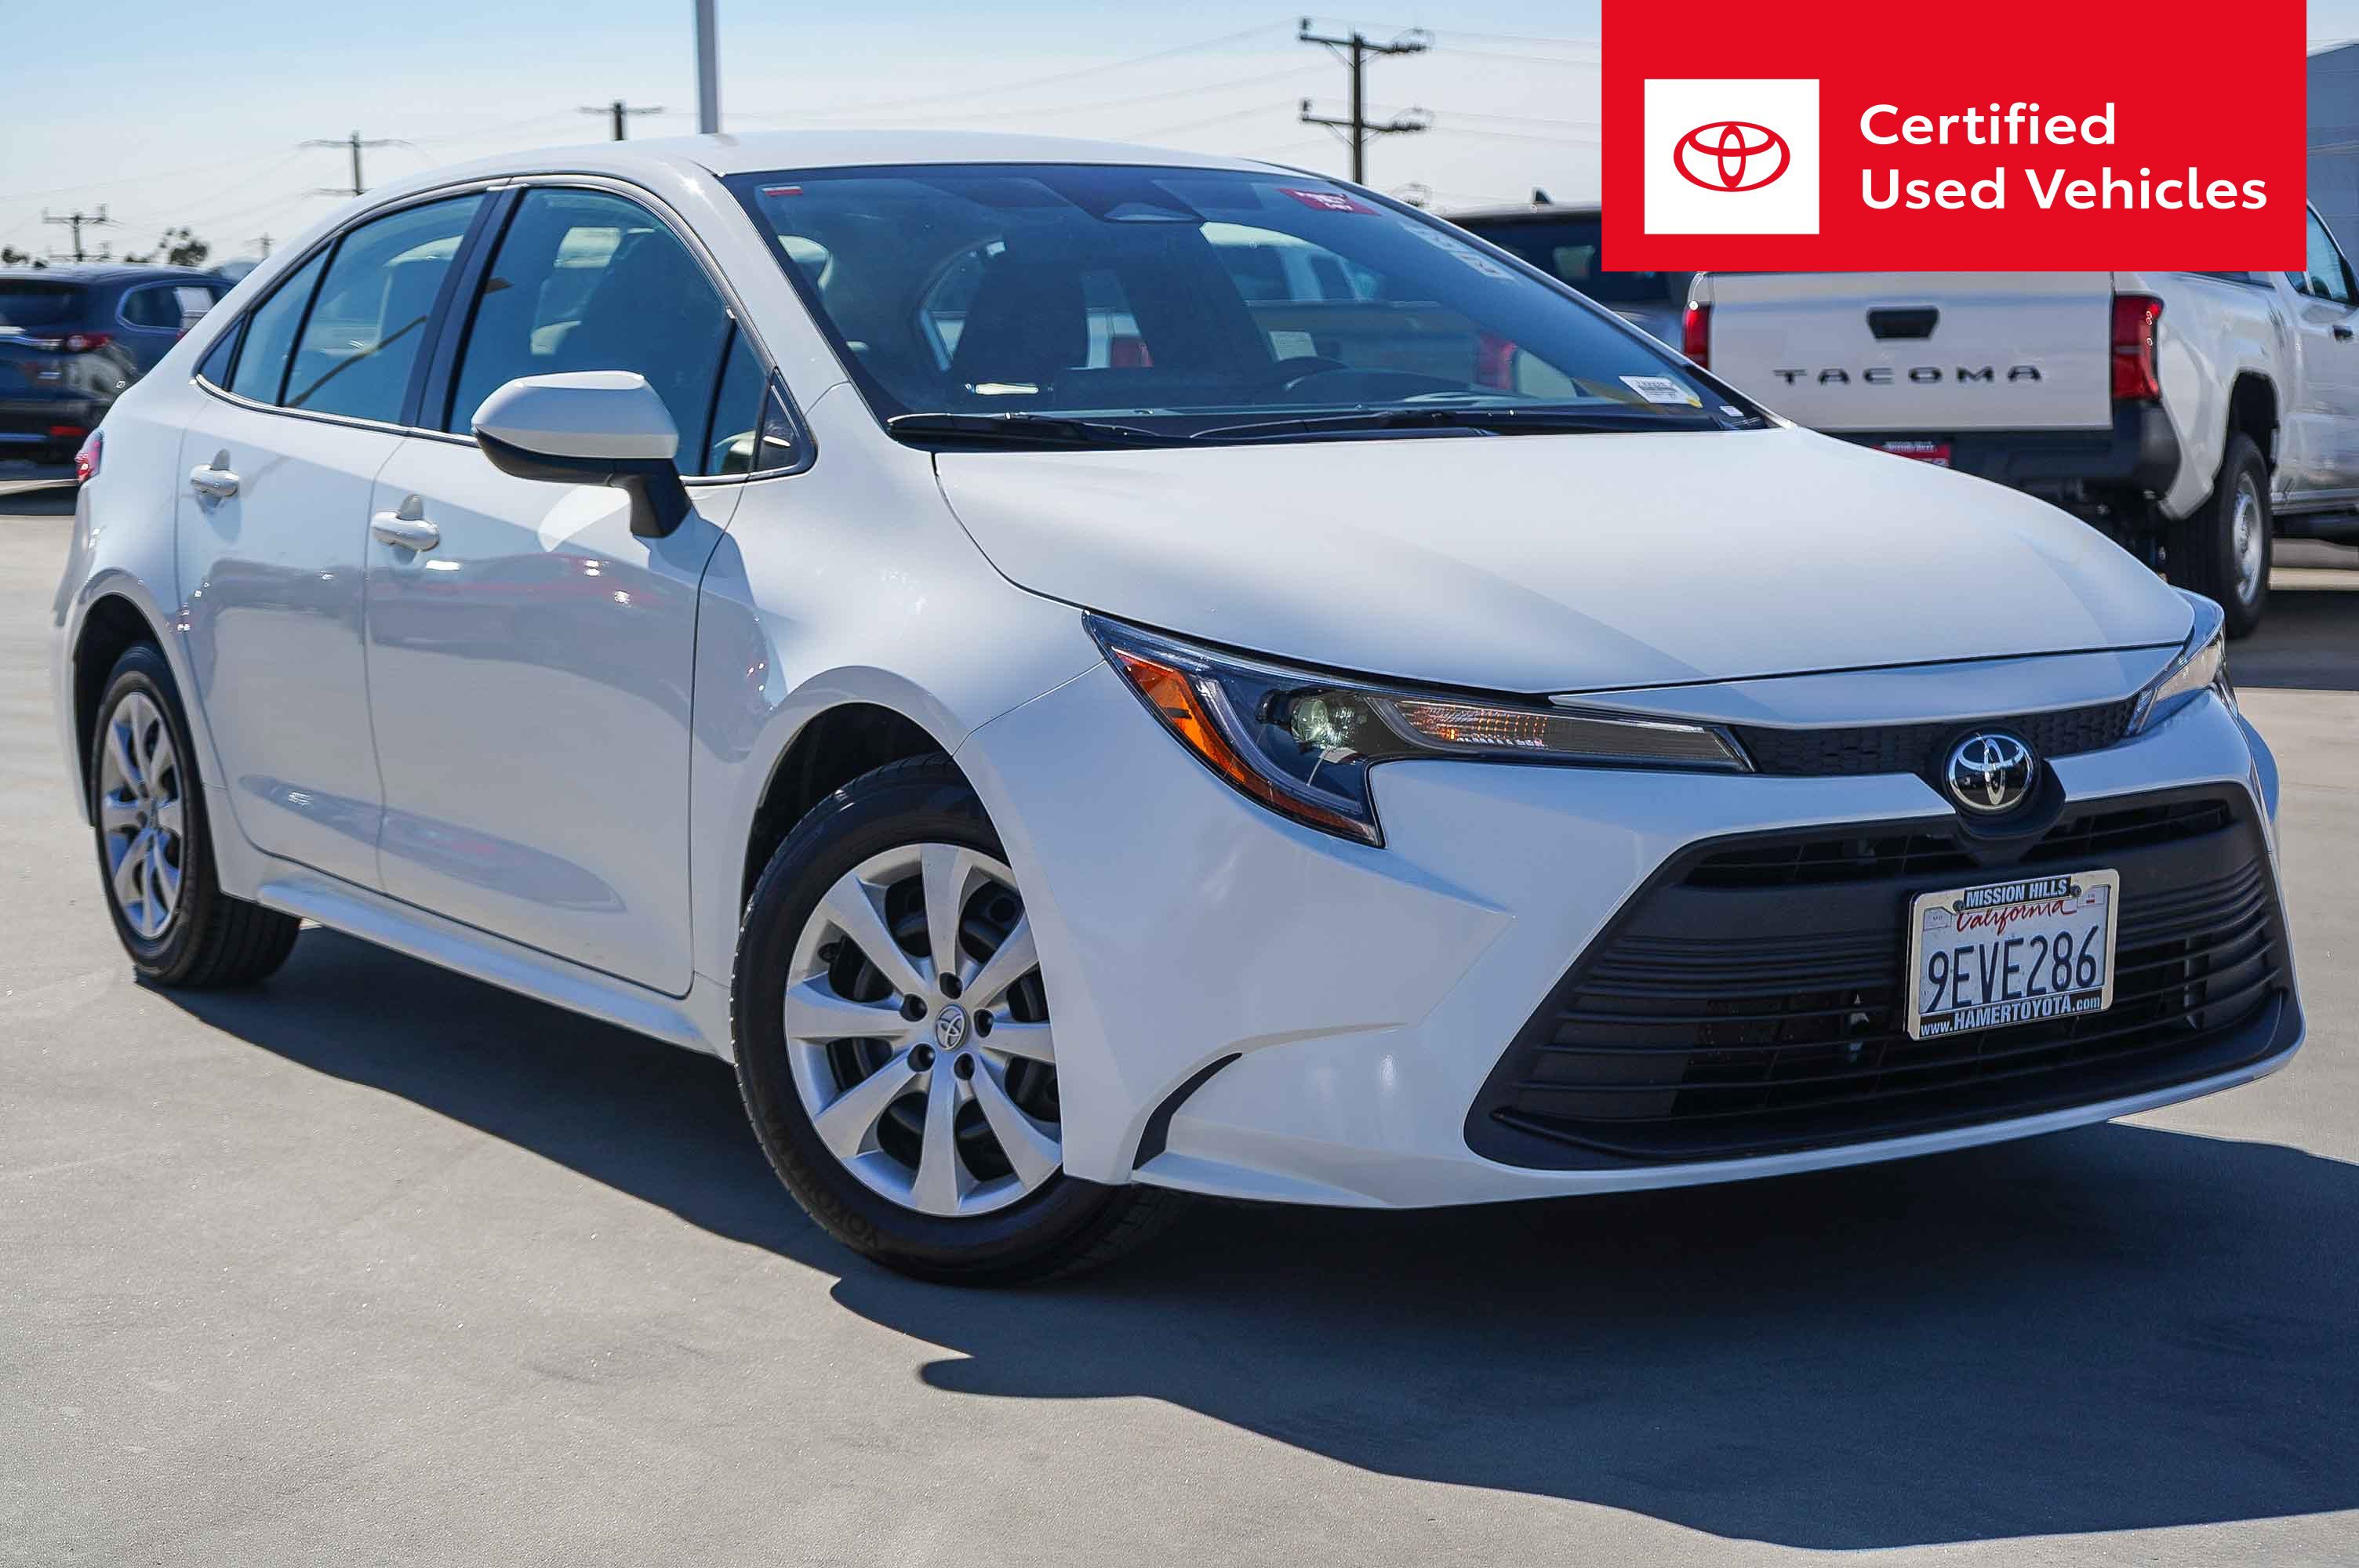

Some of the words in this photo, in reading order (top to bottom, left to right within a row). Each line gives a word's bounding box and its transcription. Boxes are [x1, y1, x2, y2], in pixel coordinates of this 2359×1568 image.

[1772, 365, 2043, 387] TACOMA
[1965, 884, 2026, 906] MISSION
[2028, 879, 2067, 898] HILLS
[1956, 900, 2077, 936] California
[1925, 924, 2099, 1014] 9EVE286
[1921, 995, 2101, 1036] www.HAMERTOYOTA.com
